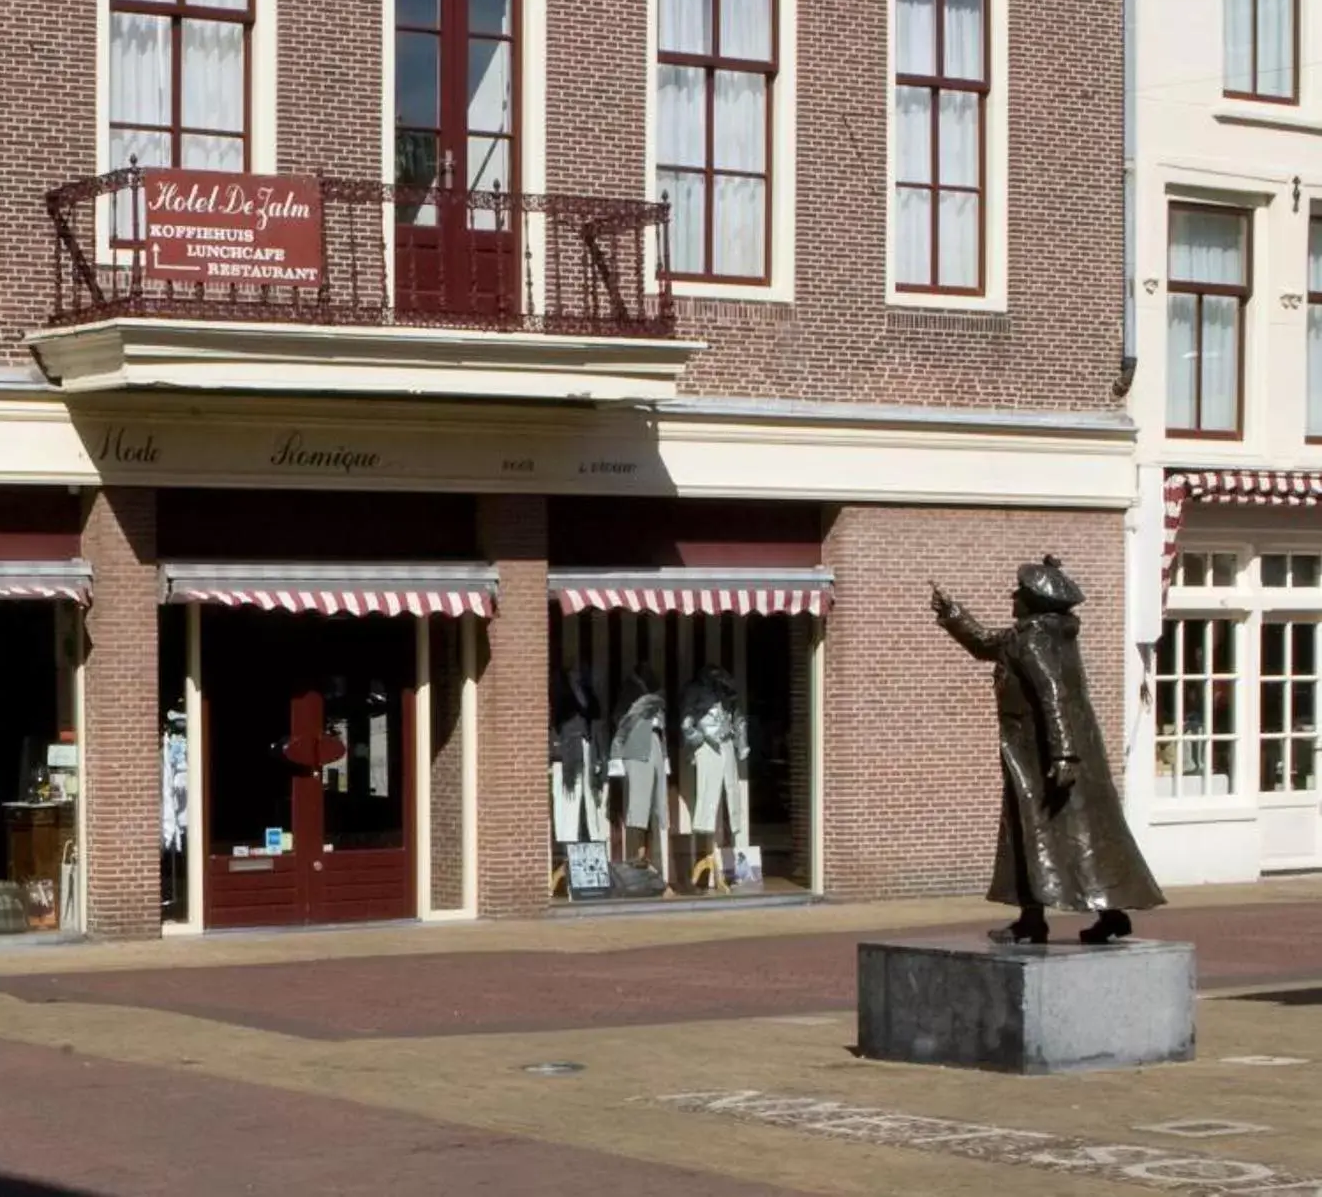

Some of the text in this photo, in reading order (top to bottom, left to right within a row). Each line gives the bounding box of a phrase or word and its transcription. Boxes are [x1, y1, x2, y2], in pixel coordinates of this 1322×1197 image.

[148, 181, 311, 231] Hotel De Zalm
[149, 223, 255, 243] KOFFIEHUIS
[186, 243, 286, 262] LUNCHCAFE
[207, 262, 319, 281] RESTAURANT
